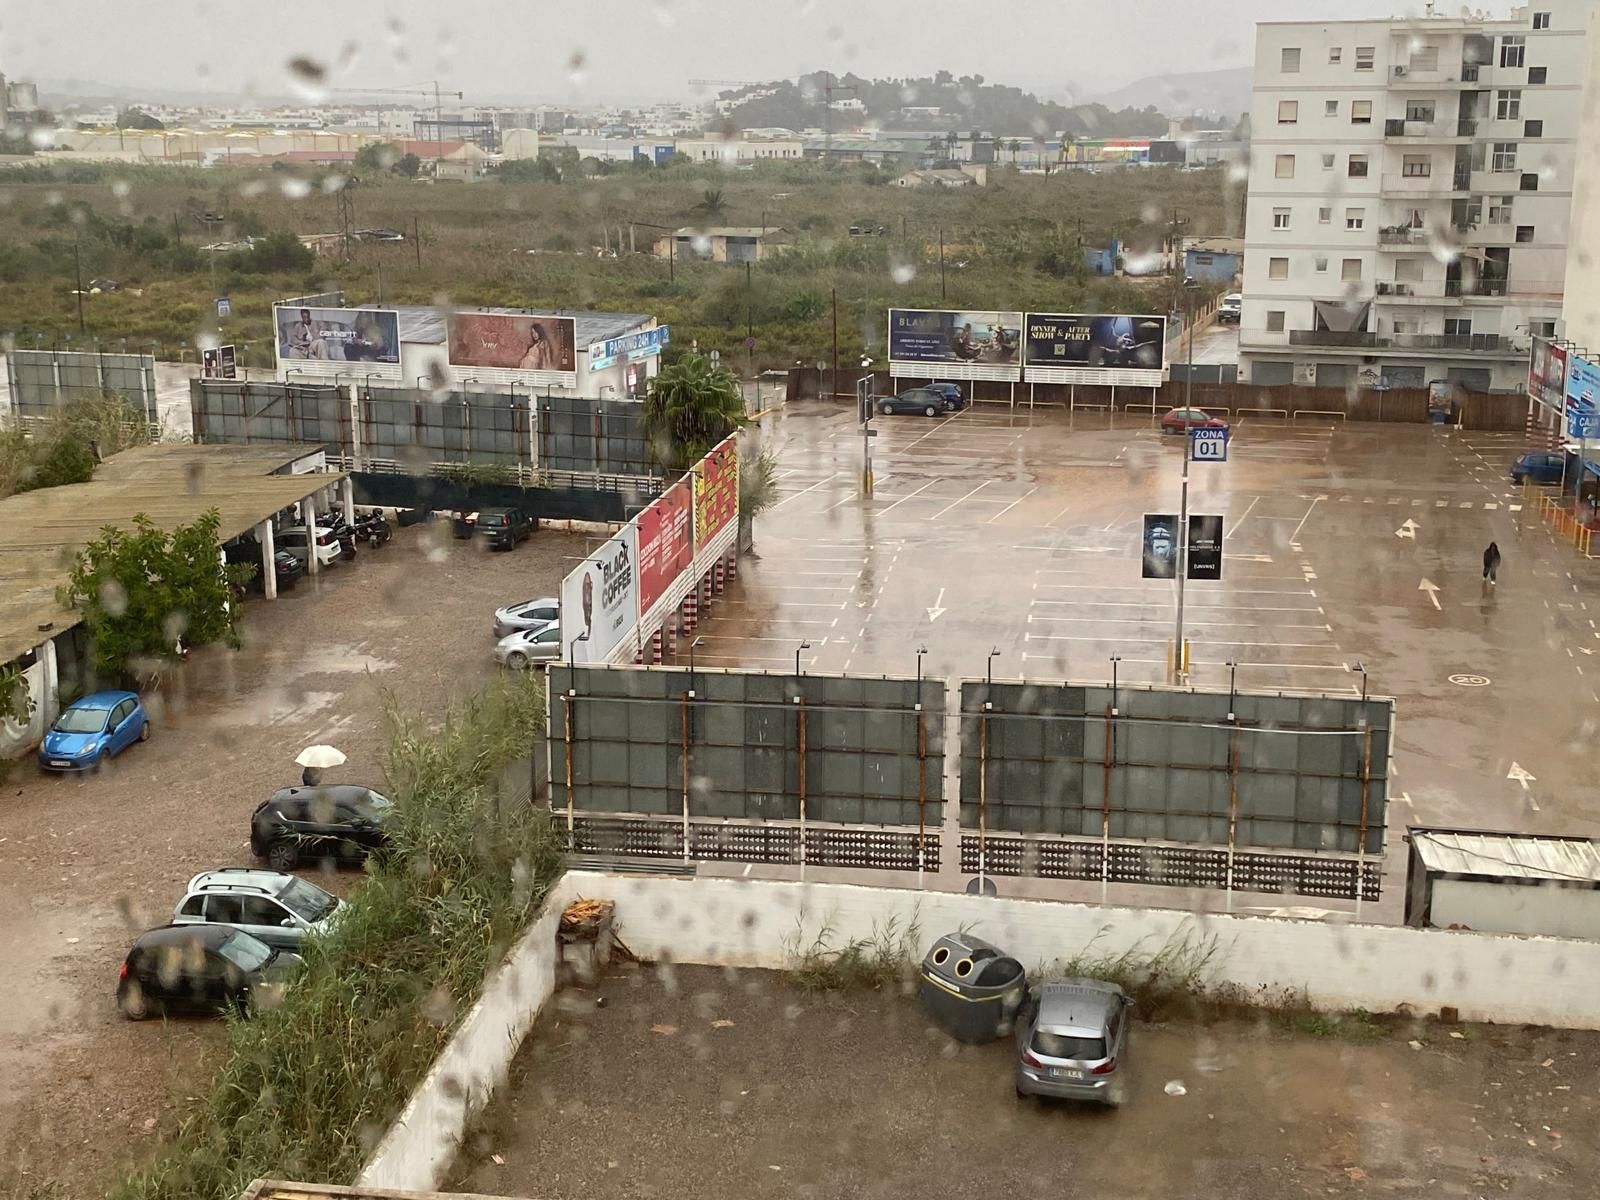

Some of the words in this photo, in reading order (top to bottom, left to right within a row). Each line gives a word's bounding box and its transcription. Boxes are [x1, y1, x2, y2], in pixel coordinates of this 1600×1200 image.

[319, 330, 357, 338] carhartt
[1030, 325, 1056, 333] DINNER
[1031, 331, 1055, 340] SHOW
[1064, 333, 1091, 341] PARTY
[609, 336, 637, 355] PARKING
[637, 333, 649, 348] 24H
[1195, 430, 1224, 439] ZONA
[1199, 441, 1219, 456] 01
[603, 545, 629, 584] BLACK
[602, 565, 631, 609] COFFEE
[1455, 676, 1483, 684] 20
